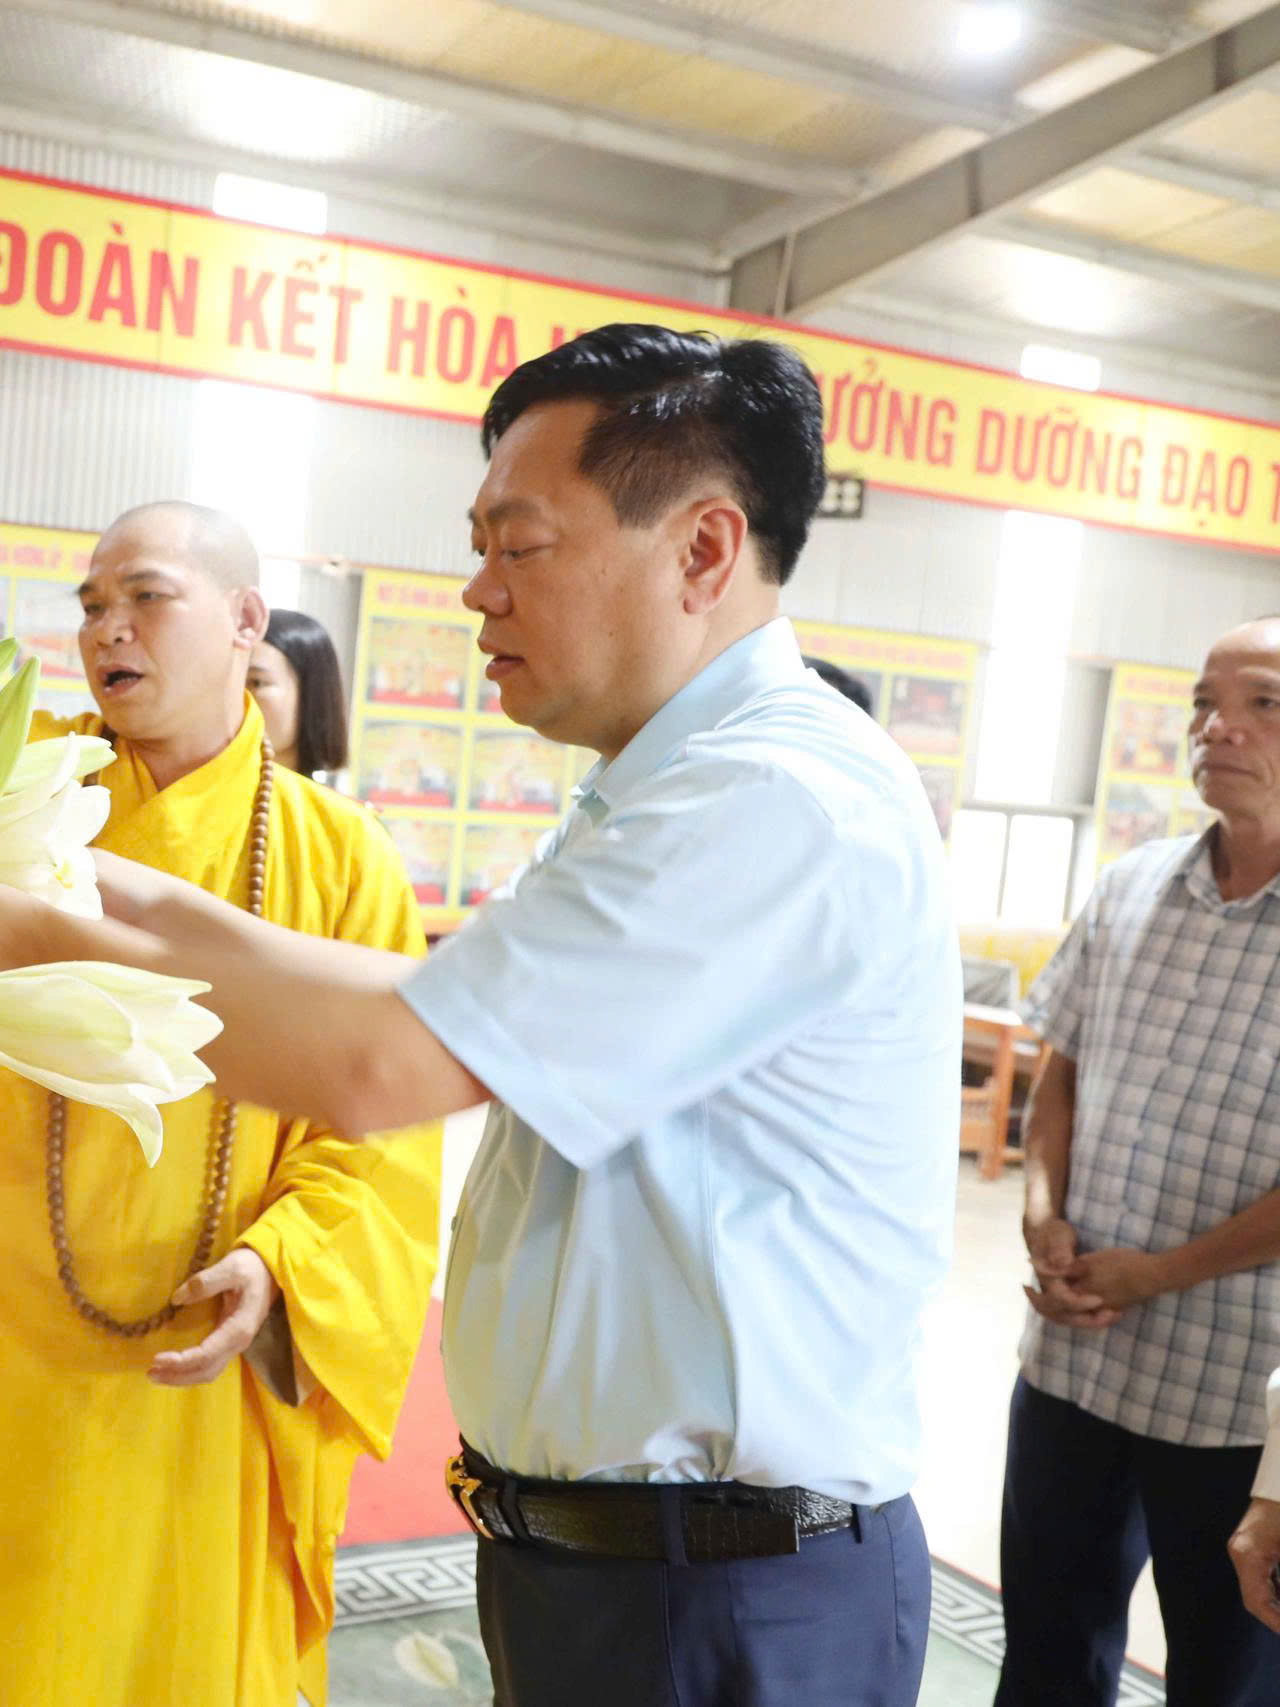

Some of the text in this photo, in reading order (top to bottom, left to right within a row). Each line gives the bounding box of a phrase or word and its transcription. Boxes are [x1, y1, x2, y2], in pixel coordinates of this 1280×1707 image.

[228, 254, 363, 367] KẾT
[387, 285, 520, 388] HÒA
[974, 405, 1144, 500] DƯỠNG
[1162, 443, 1252, 528] ĐẠO
